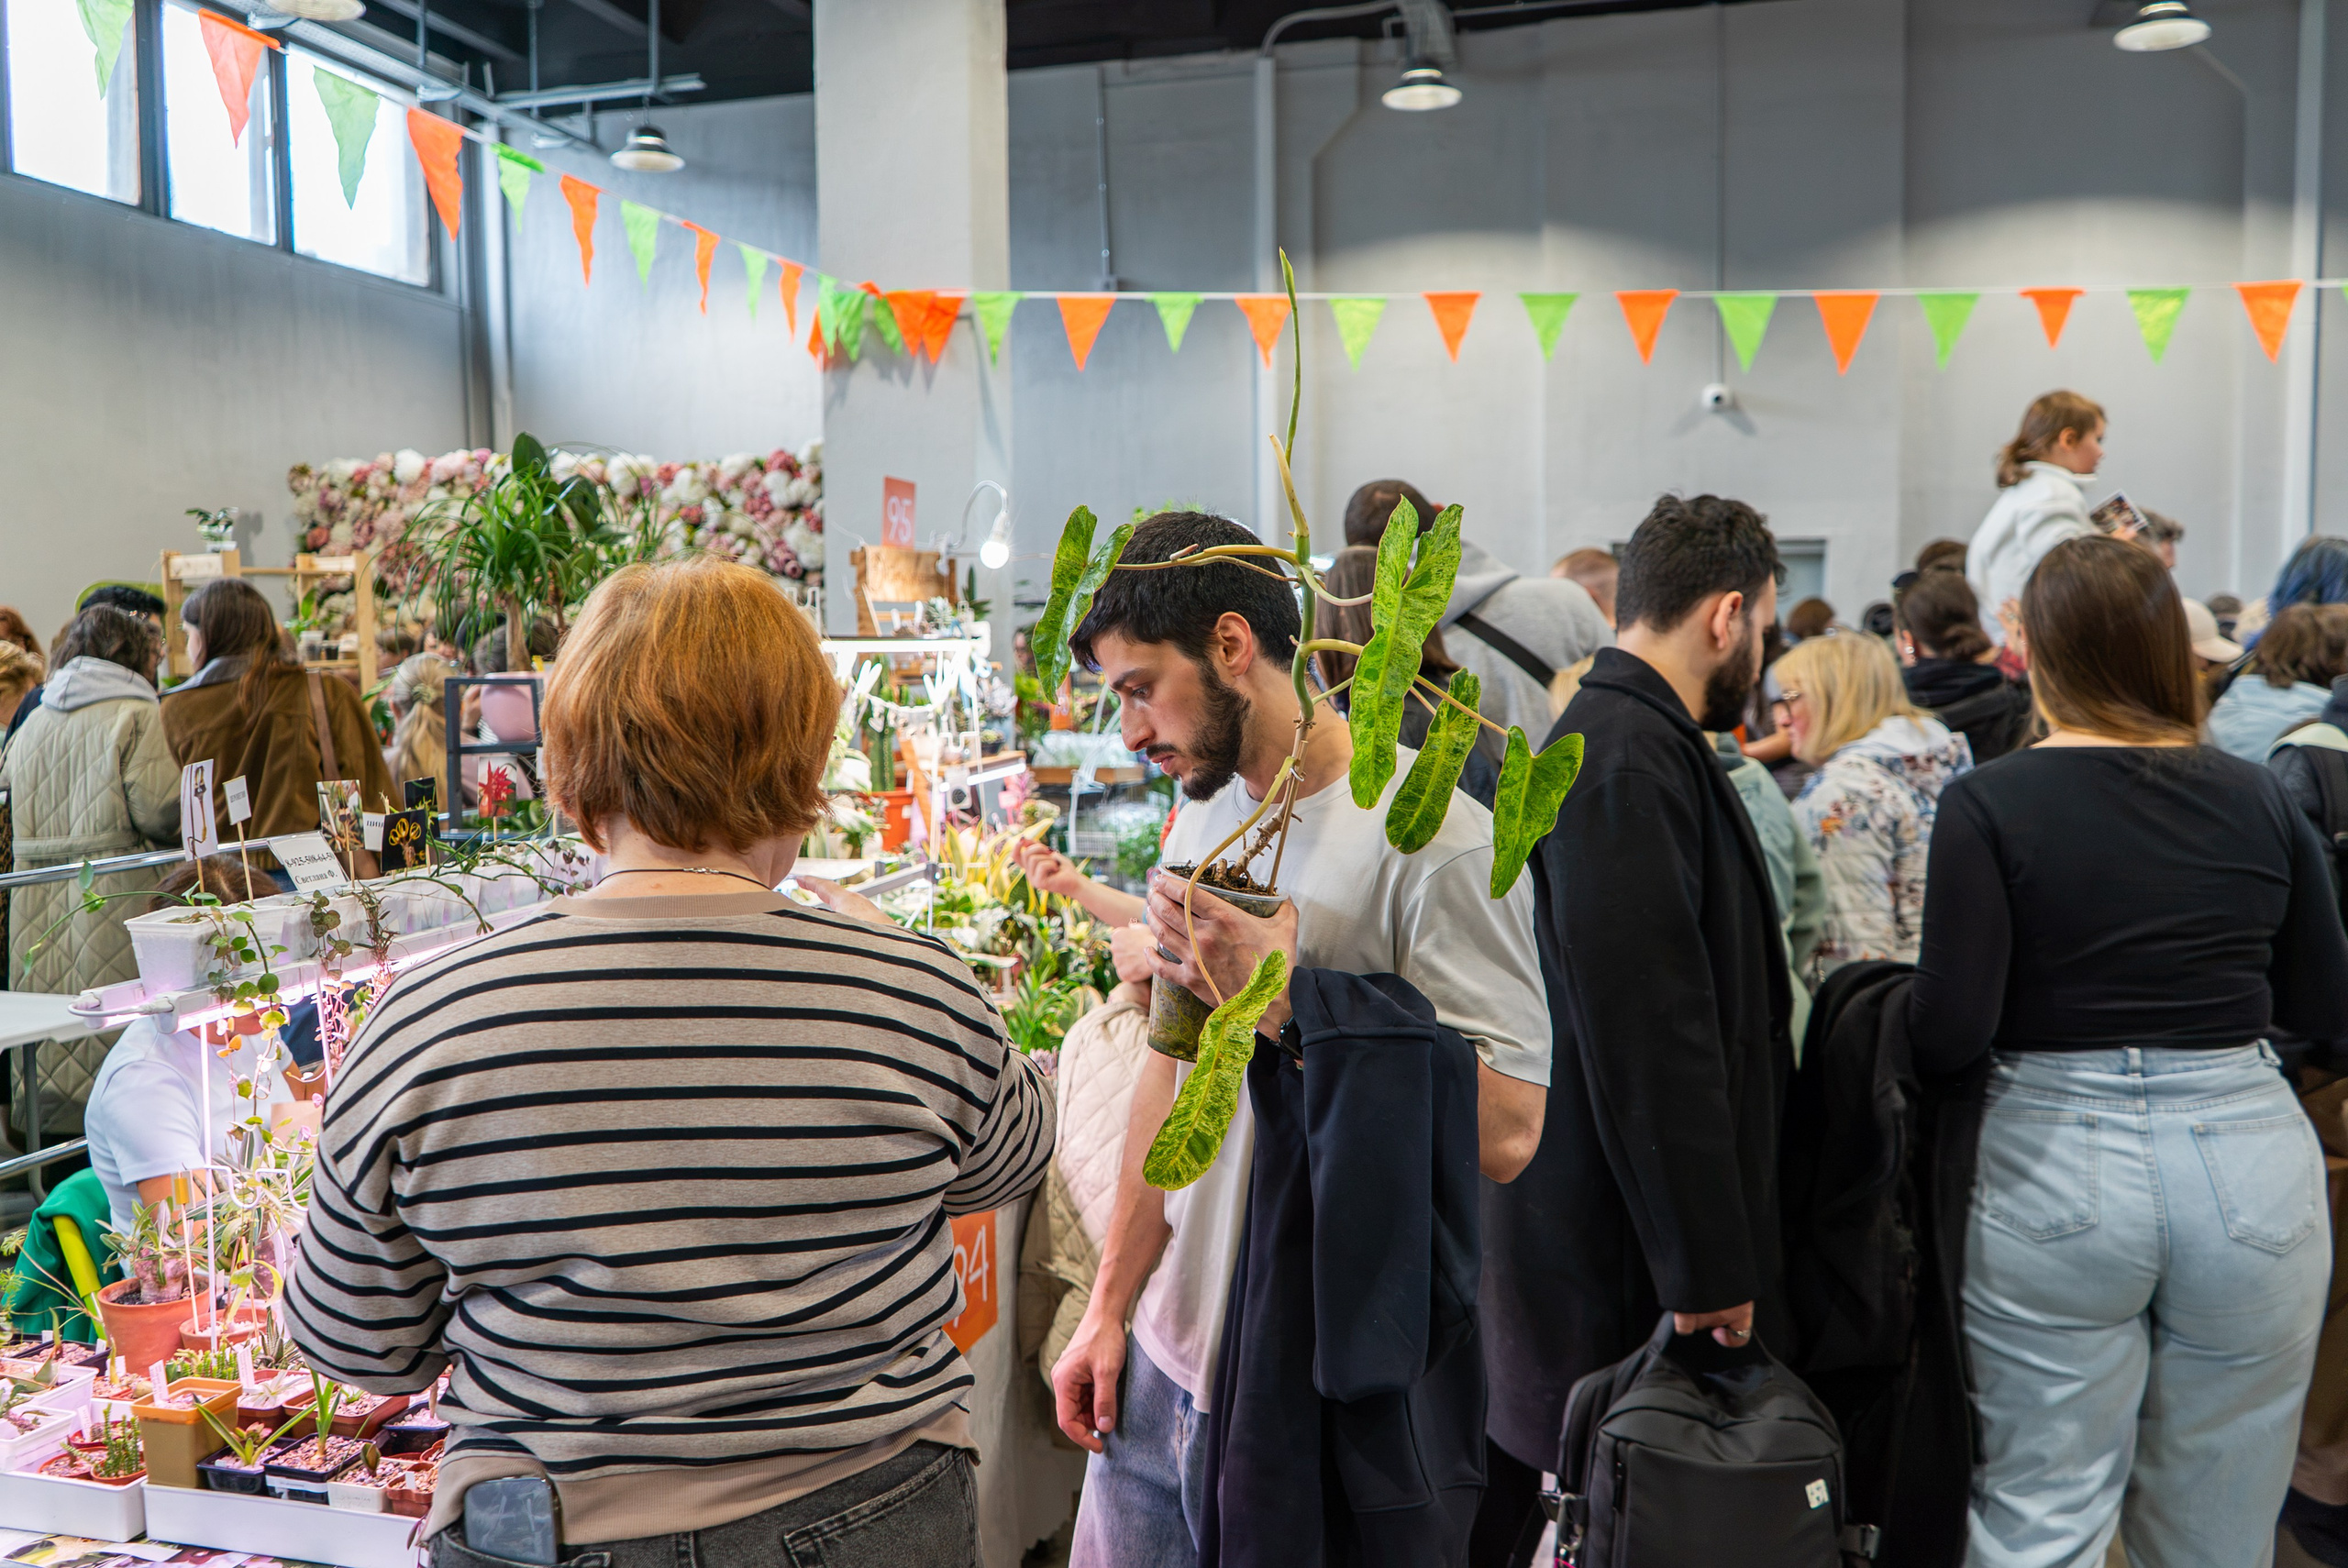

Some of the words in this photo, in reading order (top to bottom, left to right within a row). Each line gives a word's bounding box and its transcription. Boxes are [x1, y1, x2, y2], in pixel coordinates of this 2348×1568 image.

[887, 496, 912, 544] 95
[294, 872, 328, 884] Светлана
[327, 869, 338, 878] Ф.
